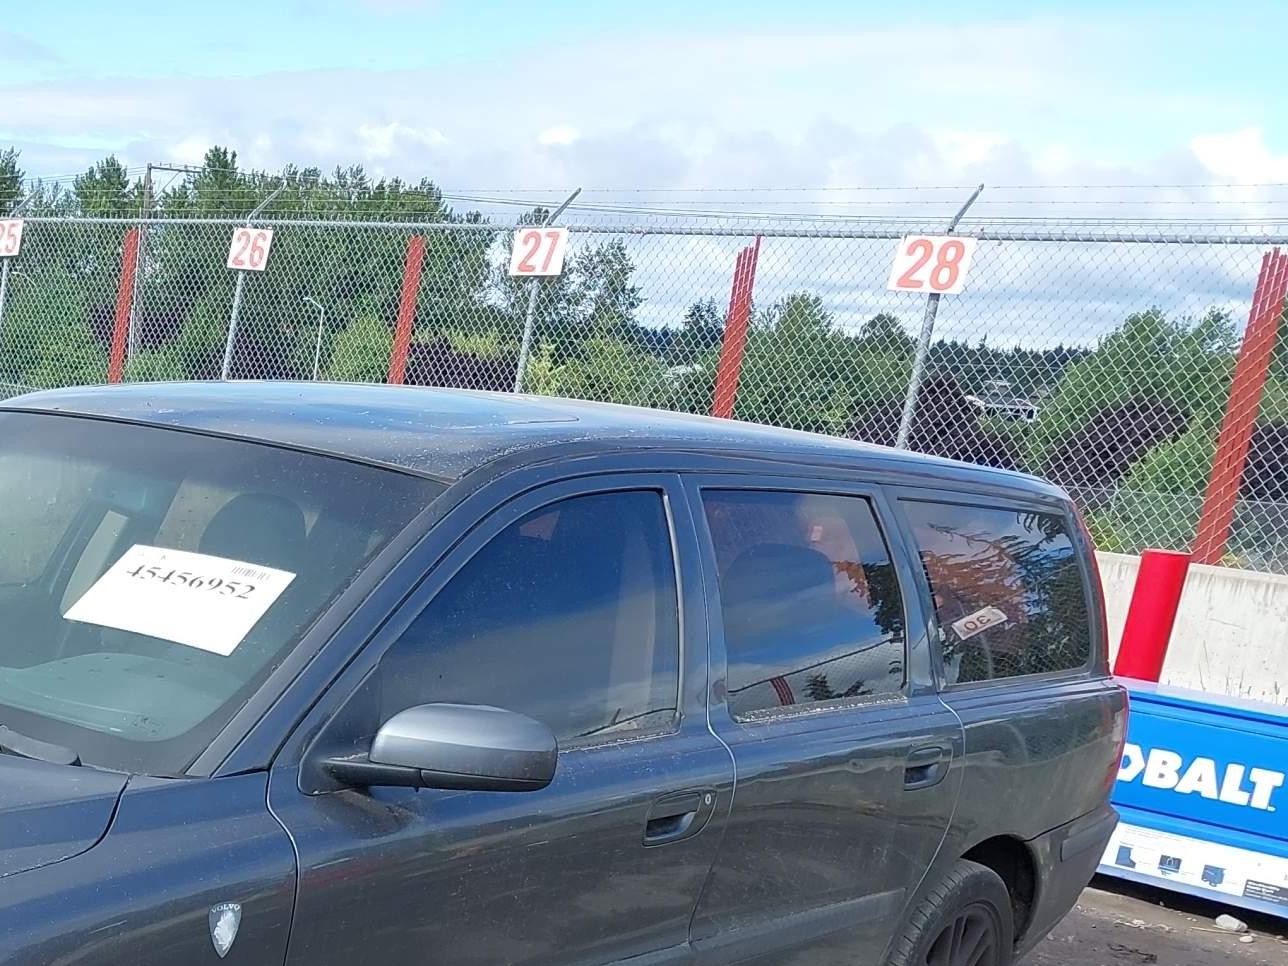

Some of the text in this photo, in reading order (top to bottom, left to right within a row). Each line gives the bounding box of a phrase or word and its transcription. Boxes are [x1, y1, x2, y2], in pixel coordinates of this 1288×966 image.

[232, 231, 267, 267] 26
[518, 231, 560, 272] 27
[896, 239, 965, 290] 28
[126, 564, 256, 600] 45456952
[1116, 743, 1285, 811] OBALT
[211, 903, 241, 913] VOLVO
